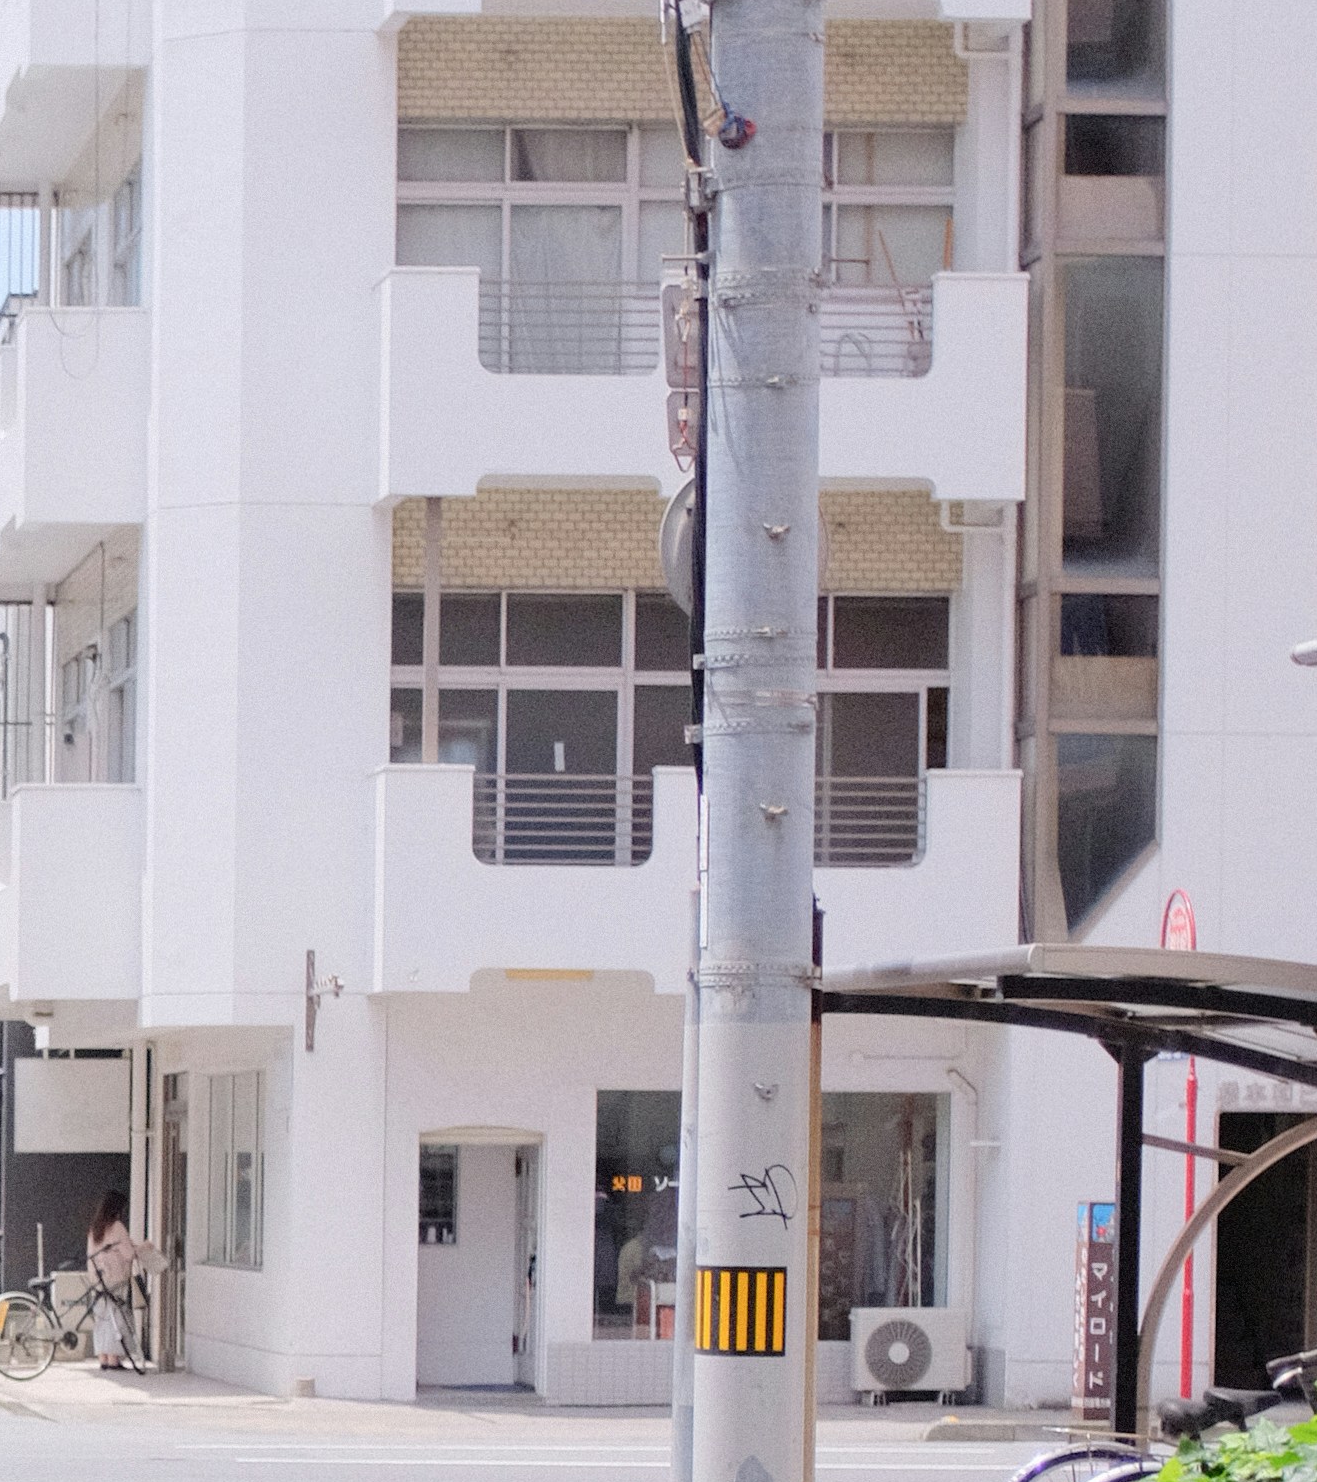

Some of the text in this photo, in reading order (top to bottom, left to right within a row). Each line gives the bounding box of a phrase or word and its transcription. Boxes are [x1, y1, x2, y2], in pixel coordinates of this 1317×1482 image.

[1089, 1262, 1108, 1390] マイロード
